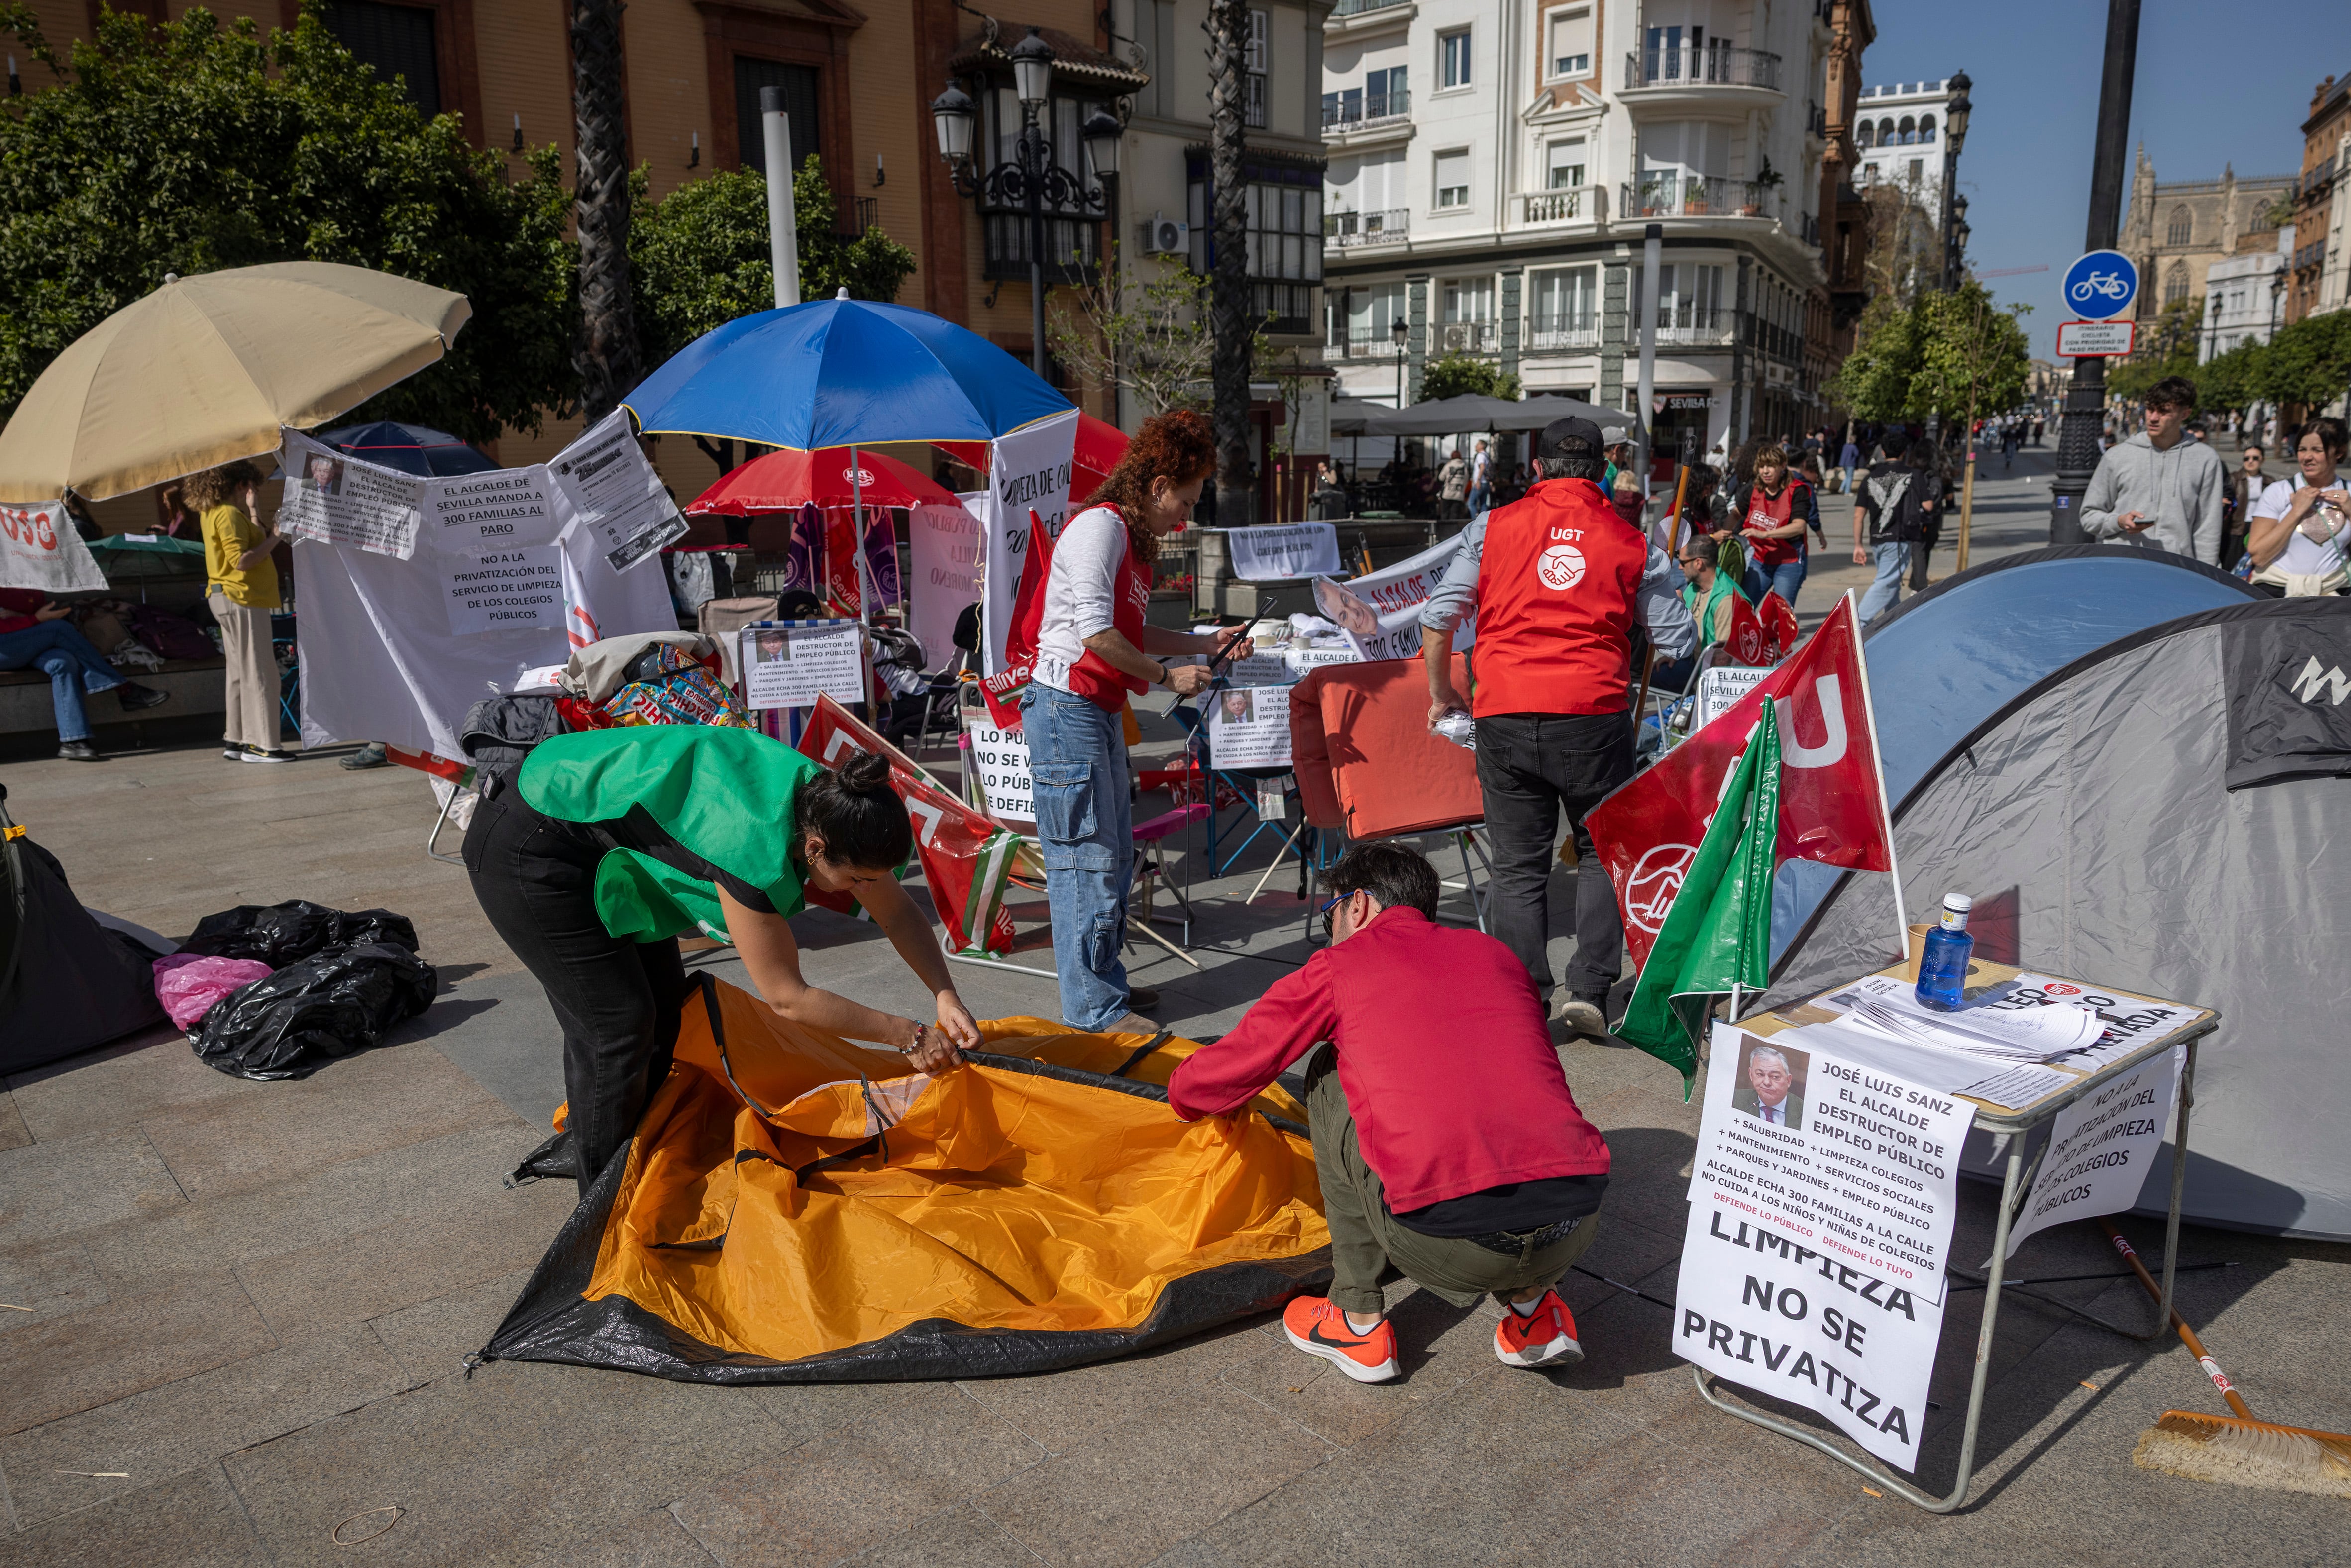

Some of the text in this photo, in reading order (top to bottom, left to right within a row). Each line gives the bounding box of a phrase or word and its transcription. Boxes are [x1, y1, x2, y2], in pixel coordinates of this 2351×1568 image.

[1670, 398, 1705, 409] SEVILLA
[351, 465, 416, 488] JOSÉ LUIS SANZ
[373, 480, 408, 494] ALCALDE
[444, 478, 530, 496] EL ALCALDE DE
[1040, 468, 1054, 496] DE
[346, 490, 417, 511] EMPLEO PÚBLICO
[350, 482, 403, 500] DESTRUCTOR
[437, 497, 483, 511] SEVILLA
[486, 491, 532, 503] MANDA
[443, 506, 543, 525] 300 FAMILIAS AL
[481, 524, 513, 535] PARO
[1551, 527, 1584, 541] UGT
[481, 555, 498, 565] NO
[512, 553, 525, 562] LA
[454, 566, 556, 582] PRIVATIZACIÓN DEL
[452, 581, 562, 597] SERVICIO DE LIMPIEZA
[831, 574, 861, 611] Sevilla
[1371, 575, 1430, 615] ALCALDE
[467, 595, 553, 608] DE LOS COLEGIOS
[489, 610, 537, 620] PÚBLICOS
[1711, 687, 1746, 695] SEVILLA
[1711, 701, 1728, 710] 300
[981, 731, 999, 743] LO
[977, 751, 1019, 767] NO SE
[983, 773, 996, 787] LO
[1822, 1062, 1953, 1116] JOSÉ LUIS SANZ
[2091, 1074, 2140, 1109] NO A LA
[2130, 1089, 2155, 1108] DEL
[1840, 1088, 1929, 1131] EL ALCALDE
[1819, 1102, 1944, 1158] DESTRUCTOR DE
[2076, 1138, 2093, 1157] DE
[2092, 1119, 2155, 1148] LIMPIEZA
[1742, 1120, 1923, 1191] SALUBRIDAD LIMPIEZA COLEGIOS
[1813, 1120, 1945, 1180] EMPLEO PÚBLICO
[1728, 1130, 1934, 1213] MANTENIMIENTO SERVICIOS SOCIALES
[2063, 1150, 2129, 1182] COLEGIOS
[1726, 1146, 1930, 1230] PARQUES Y JARDINES EMPLEO PÚBLICO
[1707, 1159, 1934, 1254] ALCALDE ECHA 300 FAMILIAS A LA CALLE
[2031, 1183, 2092, 1222] PÚBLICOS
[1702, 1171, 1715, 1182] NO
[1718, 1177, 1749, 1195] CUIDA
[1761, 1194, 1780, 1209] LOS
[1783, 1200, 1816, 1222] NIÑOS
[1818, 1216, 1825, 1225] Y
[1827, 1219, 1857, 1241] NIÑAS
[1860, 1235, 1875, 1248] DE
[1878, 1243, 1935, 1271] COLEGIOS
[1714, 1192, 1913, 1279] DEFIENDE LO PÚBLICO DEFIENDE LO TUYO
[1742, 1275, 1867, 1357] NO SE
[1683, 1308, 1911, 1445] PRIVATIZA
